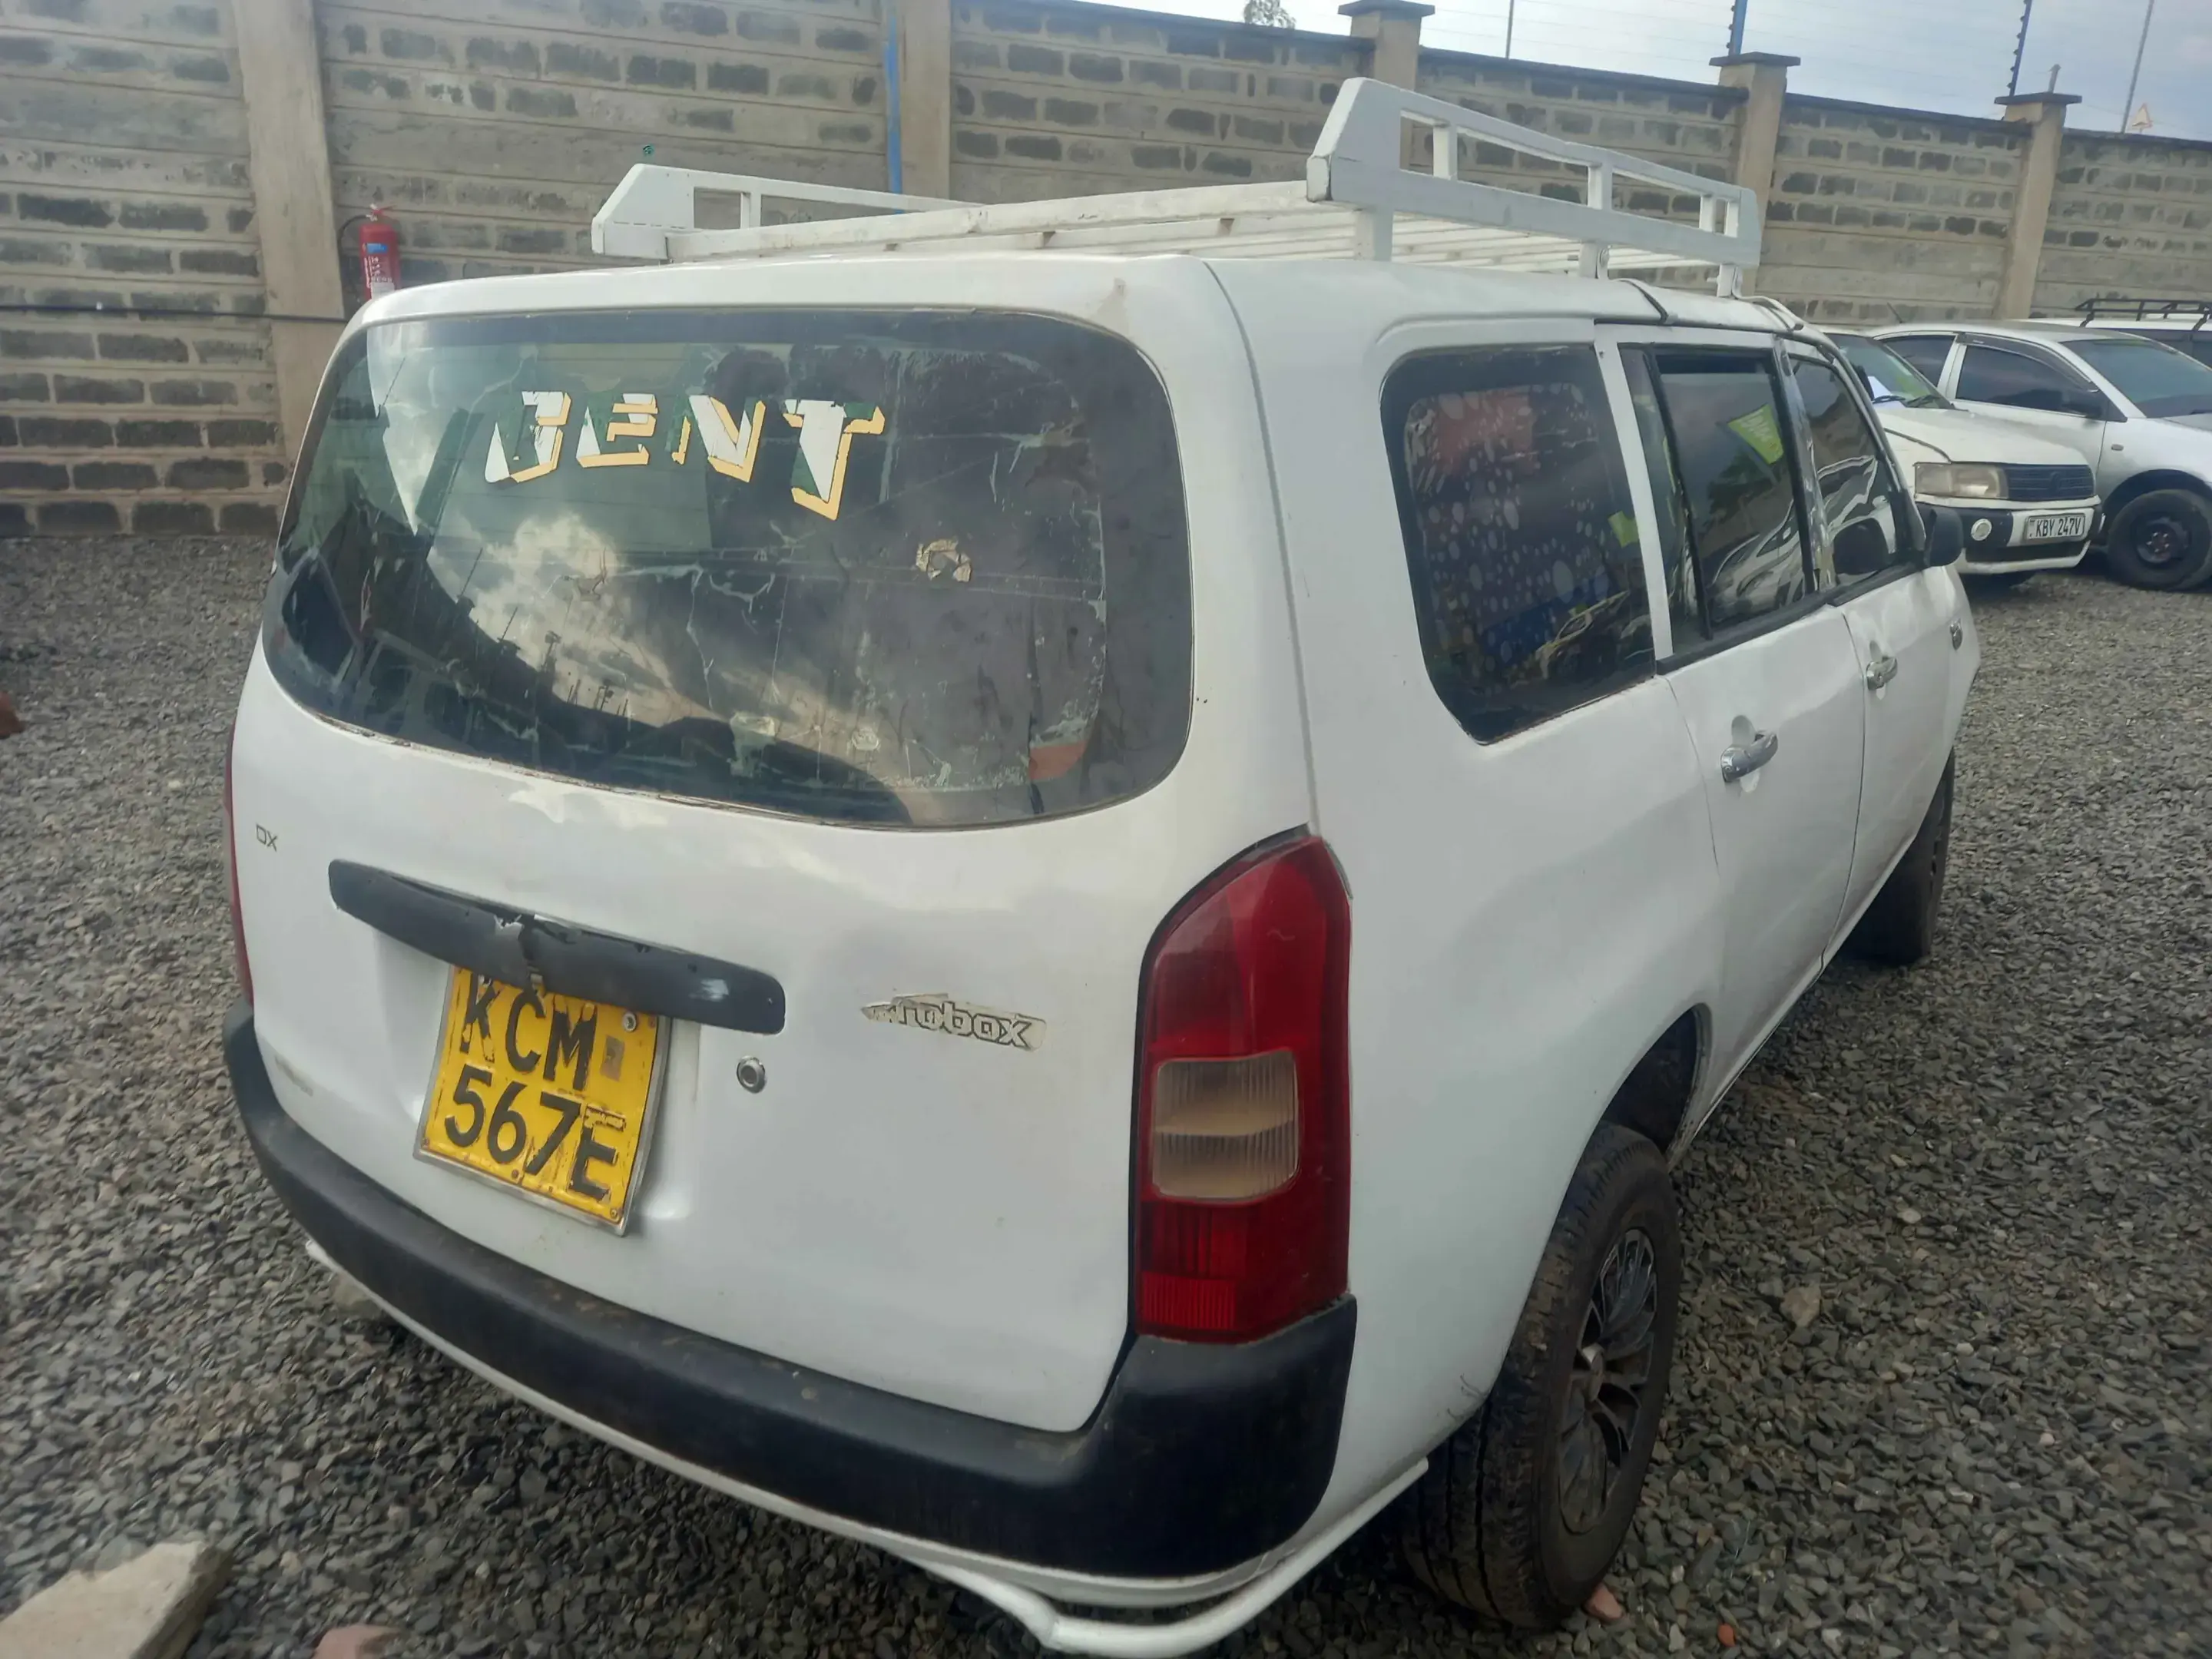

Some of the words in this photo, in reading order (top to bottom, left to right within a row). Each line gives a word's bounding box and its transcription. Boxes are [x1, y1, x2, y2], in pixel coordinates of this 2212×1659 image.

[2035, 518, 2055, 537] KBY
[2058, 516, 2081, 536] 247V
[256, 823, 277, 852] DX
[459, 969, 598, 1091] KCM
[444, 1063, 628, 1204] 567E
